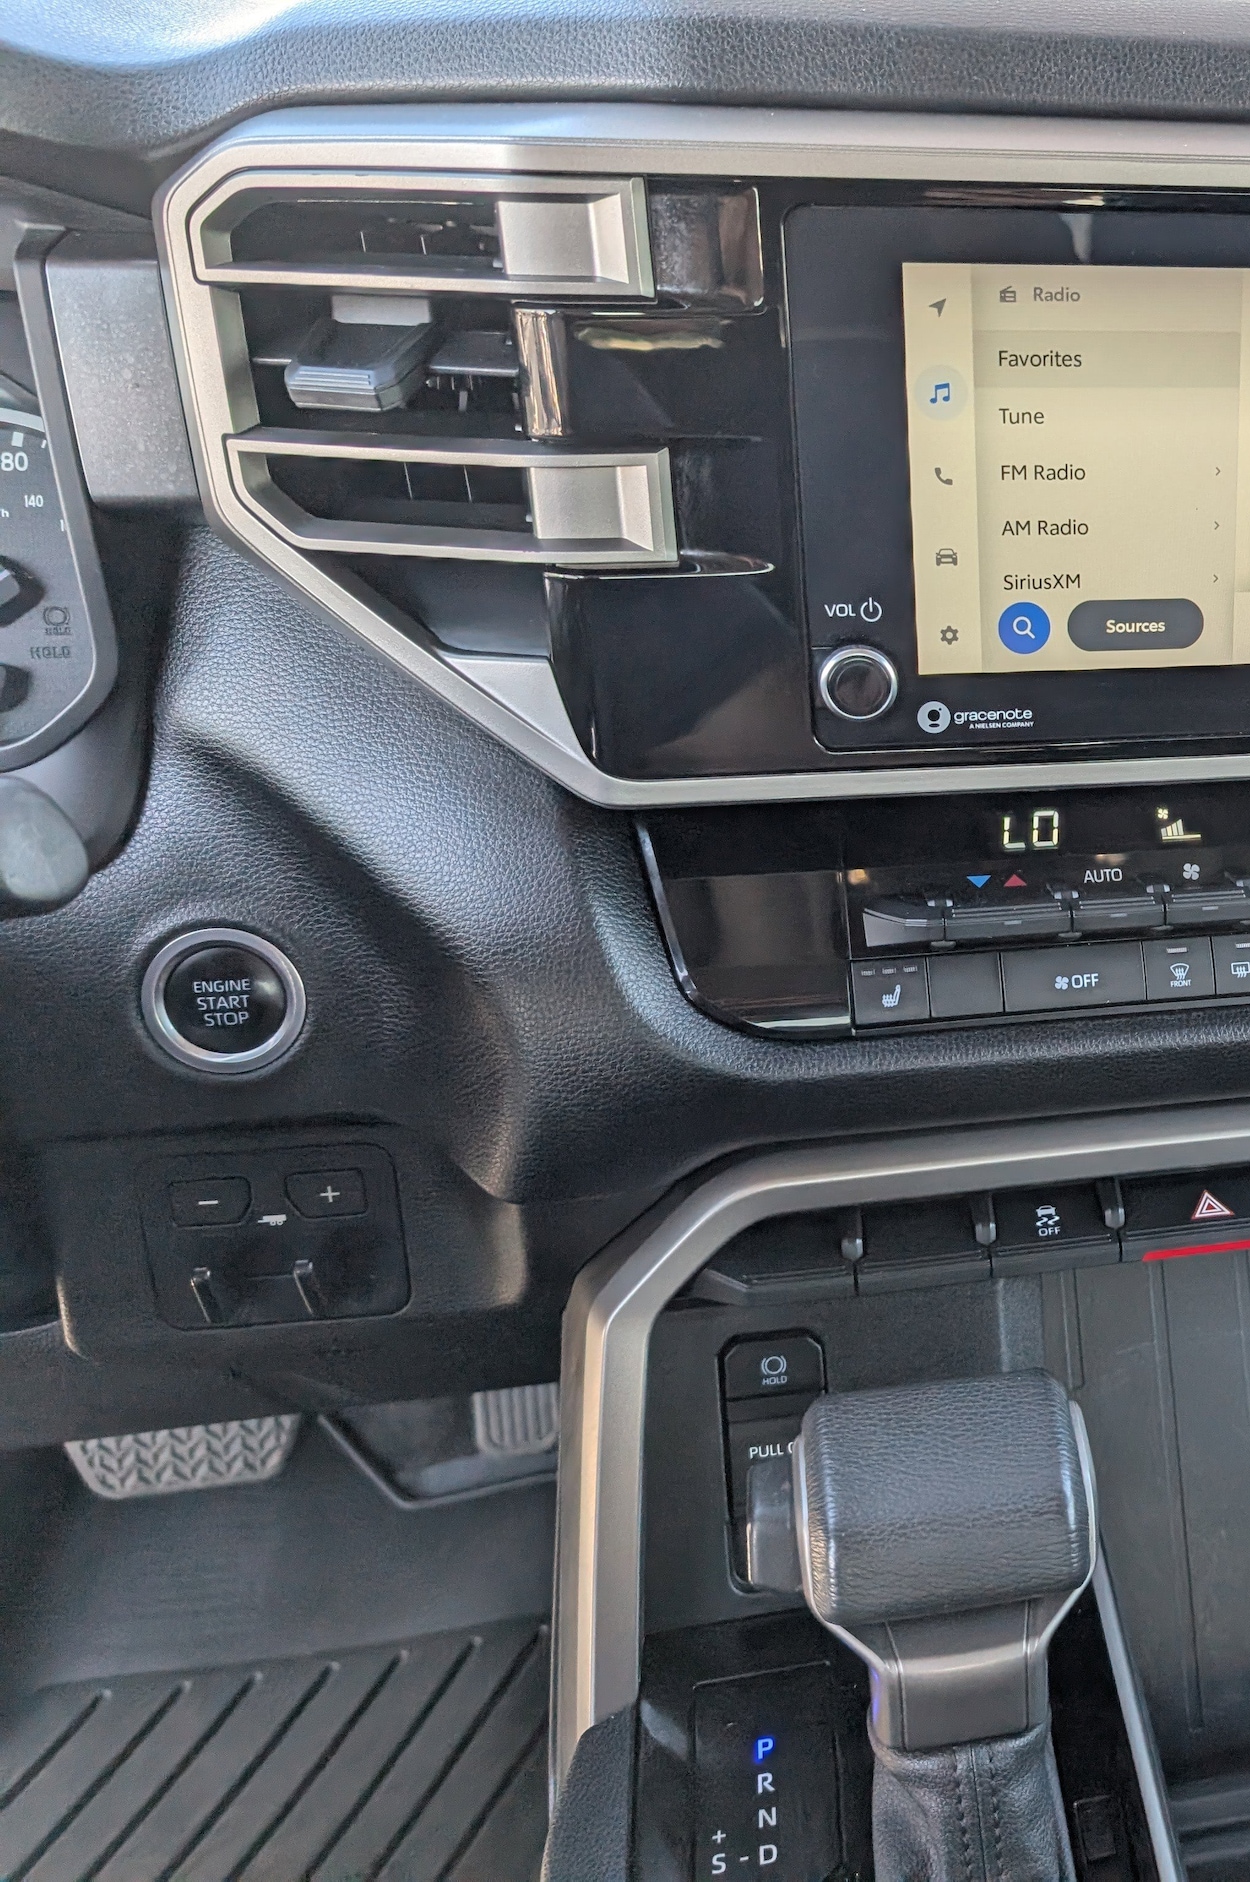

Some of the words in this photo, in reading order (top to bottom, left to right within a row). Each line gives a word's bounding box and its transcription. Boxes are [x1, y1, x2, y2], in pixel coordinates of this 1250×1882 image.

[1033, 286, 1081, 302] Radio
[998, 350, 1082, 367] Favorites
[999, 408, 1045, 424] Tune
[1000, 465, 1027, 480] FM
[1033, 464, 1086, 480] Radio
[24, 495, 44, 508] 140
[1001, 520, 1031, 536] AM
[1037, 519, 1089, 535] Radio
[1003, 574, 1081, 590] SiriusXM
[824, 603, 856, 617] VOL
[1106, 619, 1166, 634] Sources
[954, 708, 1033, 724] gracenote
[1002, 721, 1034, 729] COMPANY
[1083, 868, 1123, 883] AUTO
[193, 978, 251, 993] ENGINE
[1071, 973, 1099, 988] OFF
[1170, 979, 1191, 987] FRONT
[197, 995, 249, 1010] START
[204, 1011, 249, 1027] STOP
[1037, 1225, 1061, 1236] OFF
[762, 1374, 787, 1385] HOLD
[749, 1444, 784, 1459] PULL
[757, 1737, 774, 1760] P
[757, 1772, 775, 1794] R
[758, 1806, 777, 1828] N
[711, 1853, 727, 1874] S
[759, 1844, 778, 1865] D
